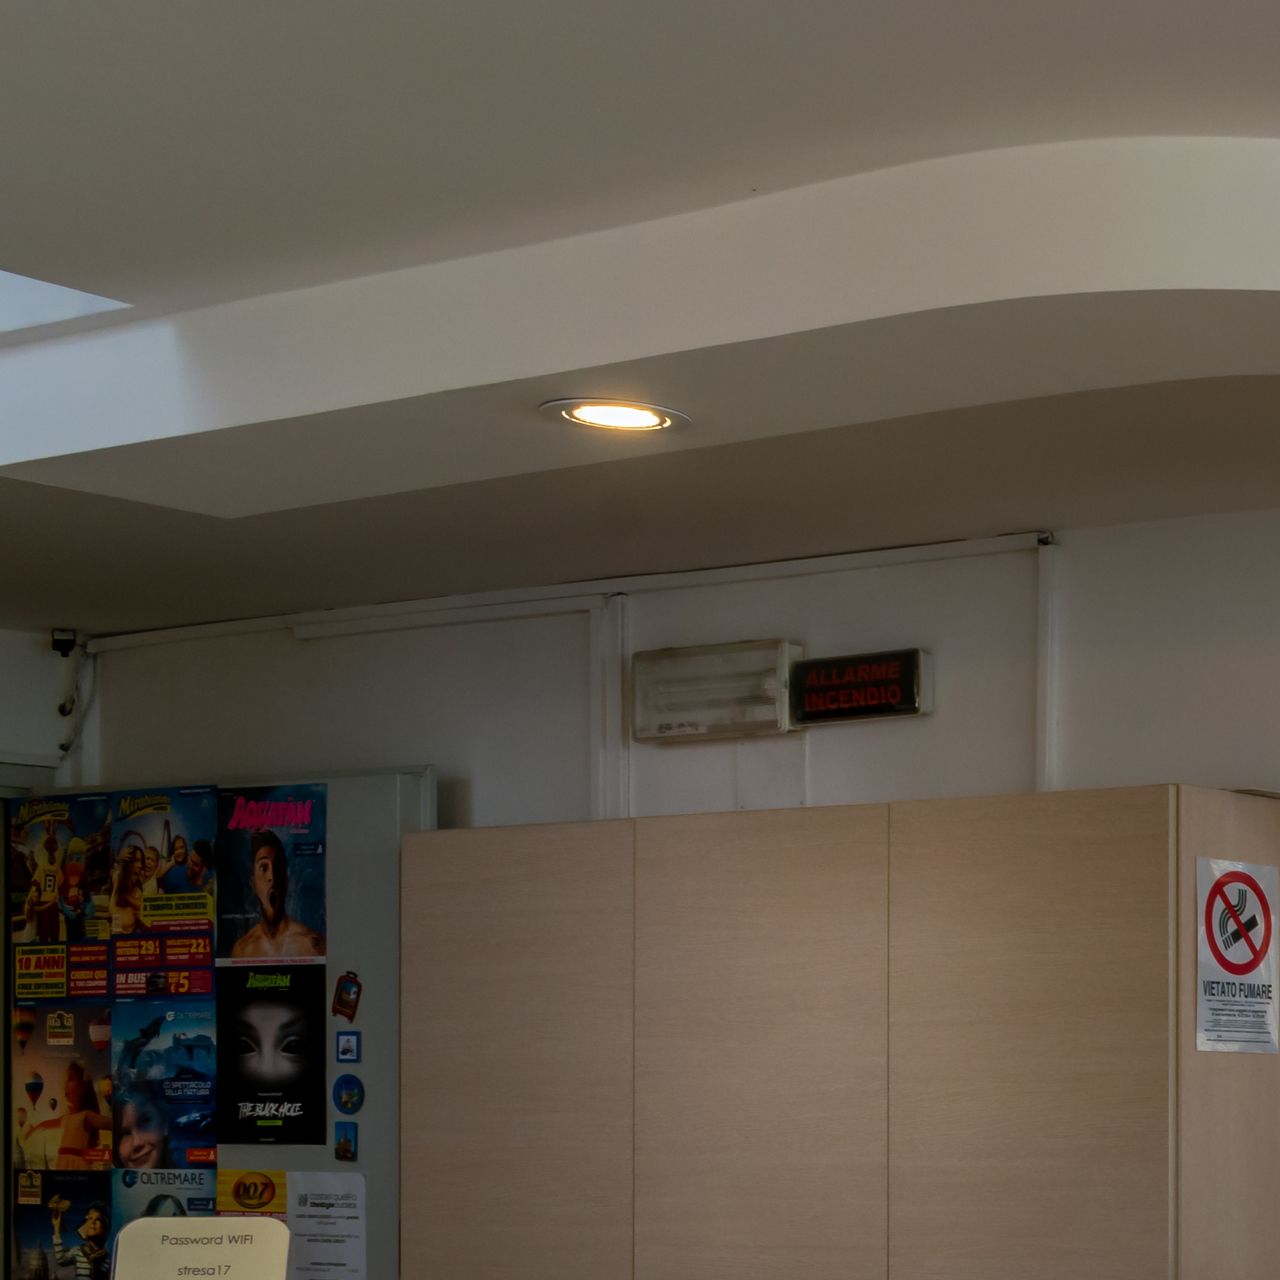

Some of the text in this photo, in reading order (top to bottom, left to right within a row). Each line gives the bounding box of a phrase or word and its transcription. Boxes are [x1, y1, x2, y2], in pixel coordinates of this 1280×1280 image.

[805, 661, 900, 687] ALLARME
[803, 684, 902, 711] INCENDIO
[18, 955, 65, 971] 10 ANNI
[115, 973, 147, 984] IN BUS
[179, 971, 190, 993] 5
[1203, 980, 1273, 1000] VIETATO FUMARE
[171, 1081, 212, 1089] SPETTACOLO
[140, 1172, 205, 1185] OLTREMARE
[235, 1181, 270, 1199] 007
[161, 1234, 253, 1246] Password WIFI
[177, 1265, 232, 1276] stresa17
